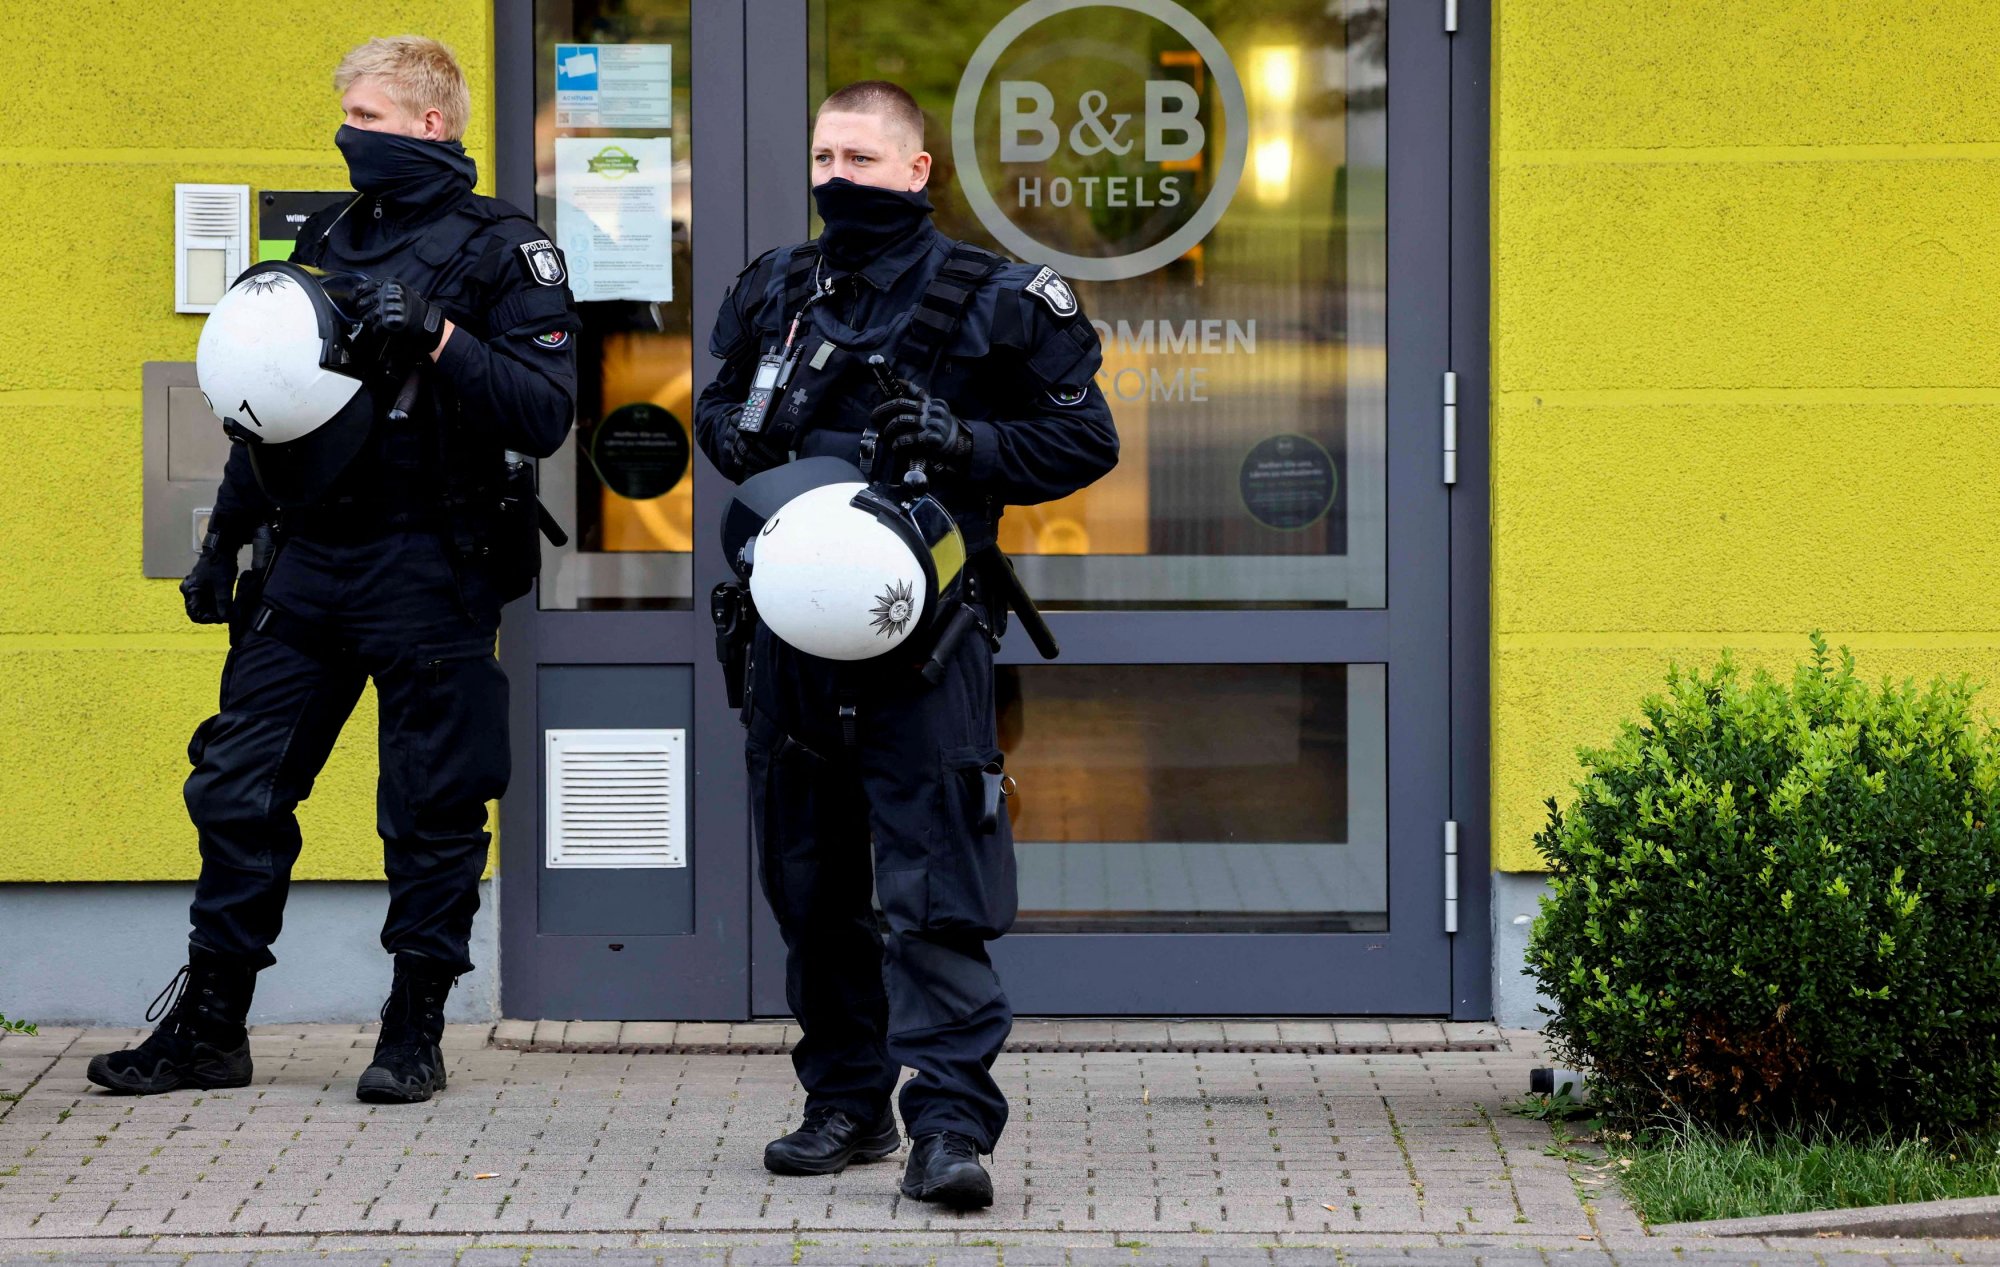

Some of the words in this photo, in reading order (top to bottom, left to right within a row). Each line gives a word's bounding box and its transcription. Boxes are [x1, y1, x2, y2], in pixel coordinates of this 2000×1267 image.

[999, 80, 1206, 163] B&B
[1018, 176, 1181, 208] HOTELS
[523, 240, 552, 253] POLIZE
[1030, 267, 1053, 292] POLIZE
